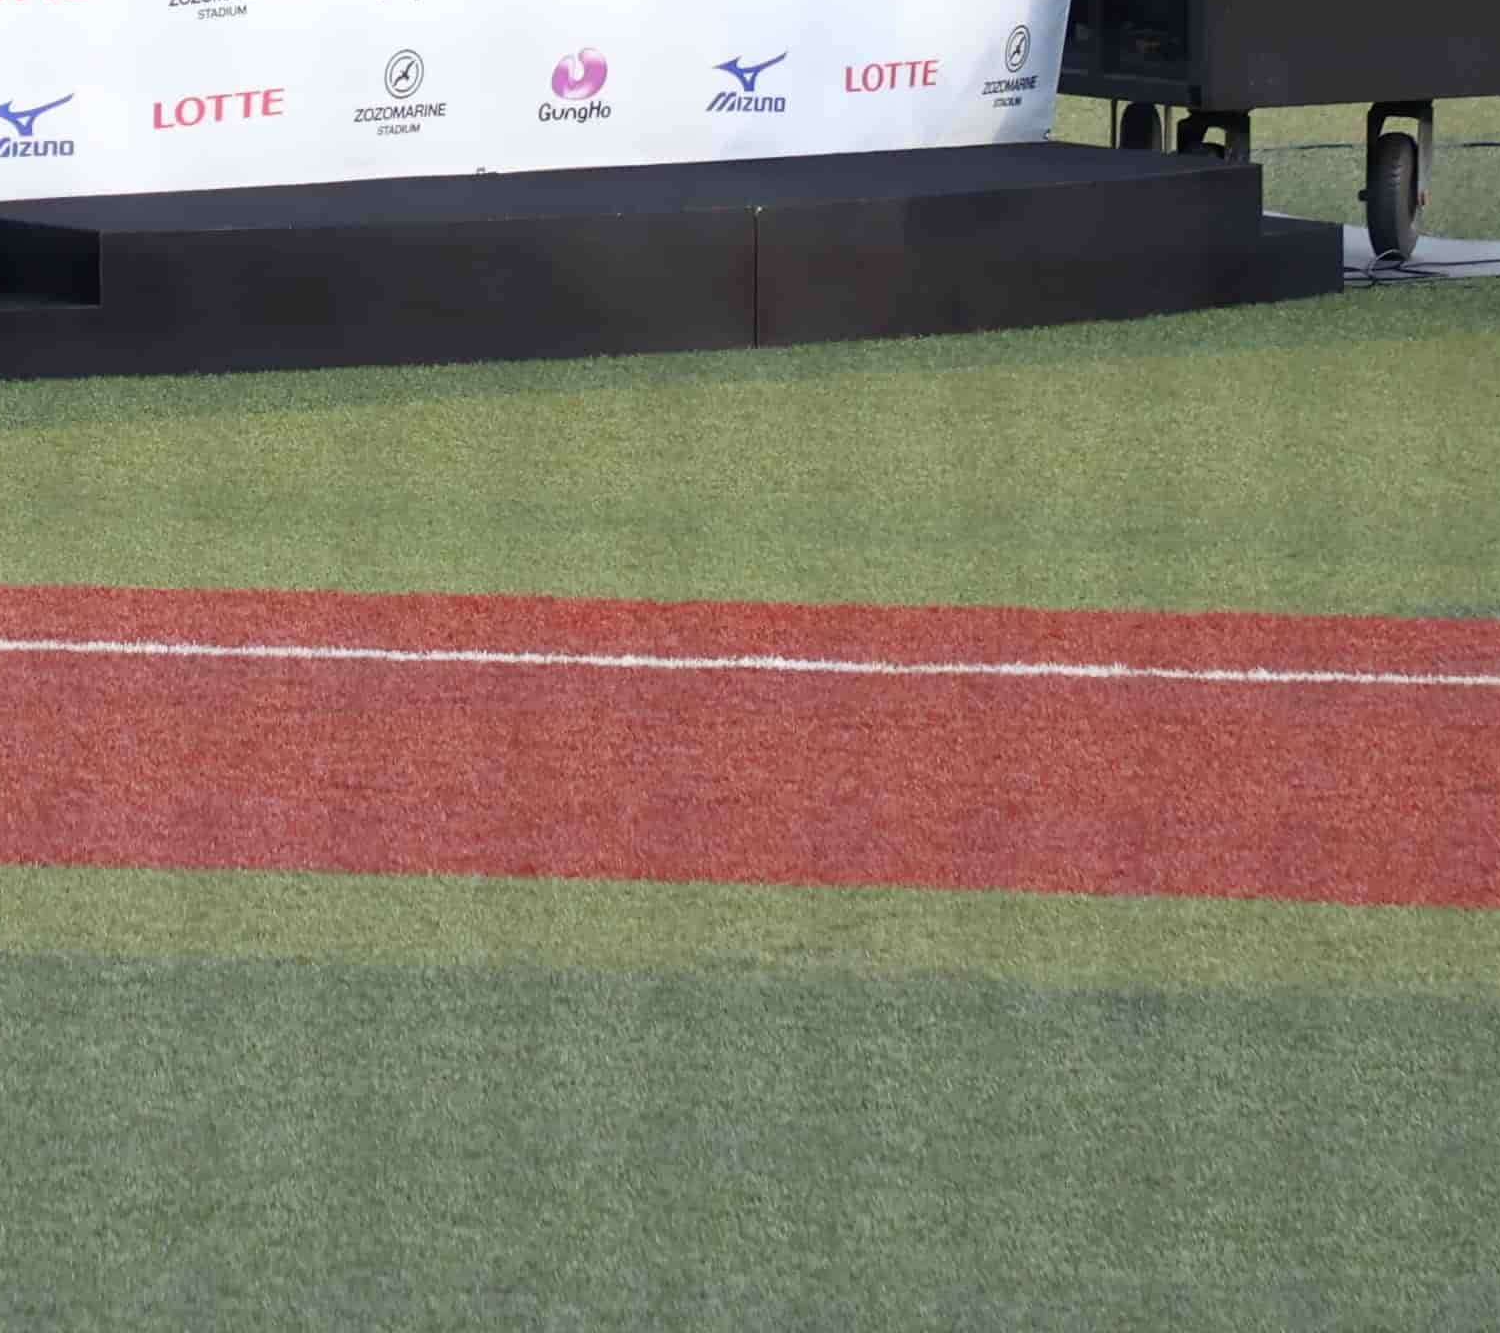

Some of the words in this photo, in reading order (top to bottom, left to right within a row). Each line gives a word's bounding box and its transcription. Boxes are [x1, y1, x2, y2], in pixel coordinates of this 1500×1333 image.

[197, 6, 247, 20] STADIUM
[845, 60, 938, 93] LOTTE
[153, 88, 285, 130] LOTTE
[354, 102, 446, 122] ZOZOMARINE
[539, 101, 611, 123] GungHo
